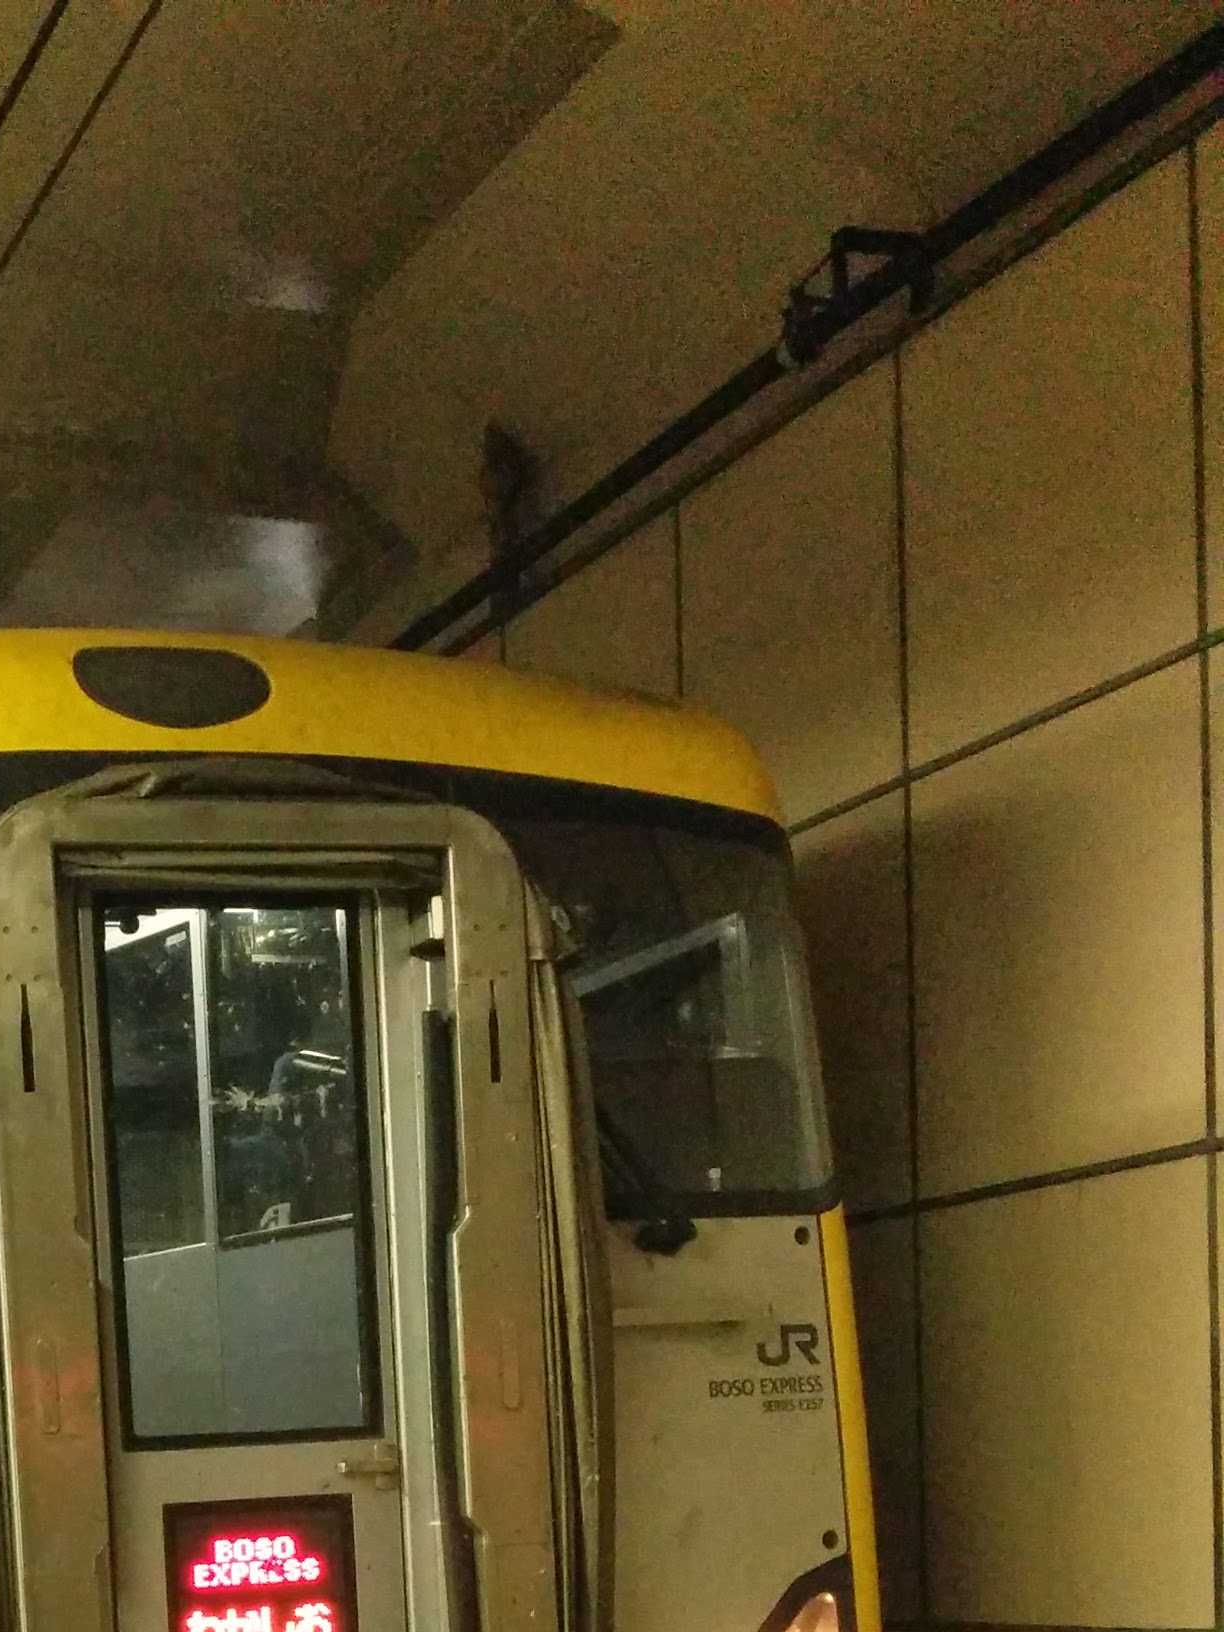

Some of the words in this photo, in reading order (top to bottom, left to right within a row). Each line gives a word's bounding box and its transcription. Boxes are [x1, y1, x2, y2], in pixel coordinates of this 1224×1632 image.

[756, 1323, 821, 1367] JR
[708, 1379, 755, 1399] BOSO
[759, 1375, 825, 1394] EXPRESS
[213, 1535, 297, 1565] BOSO
